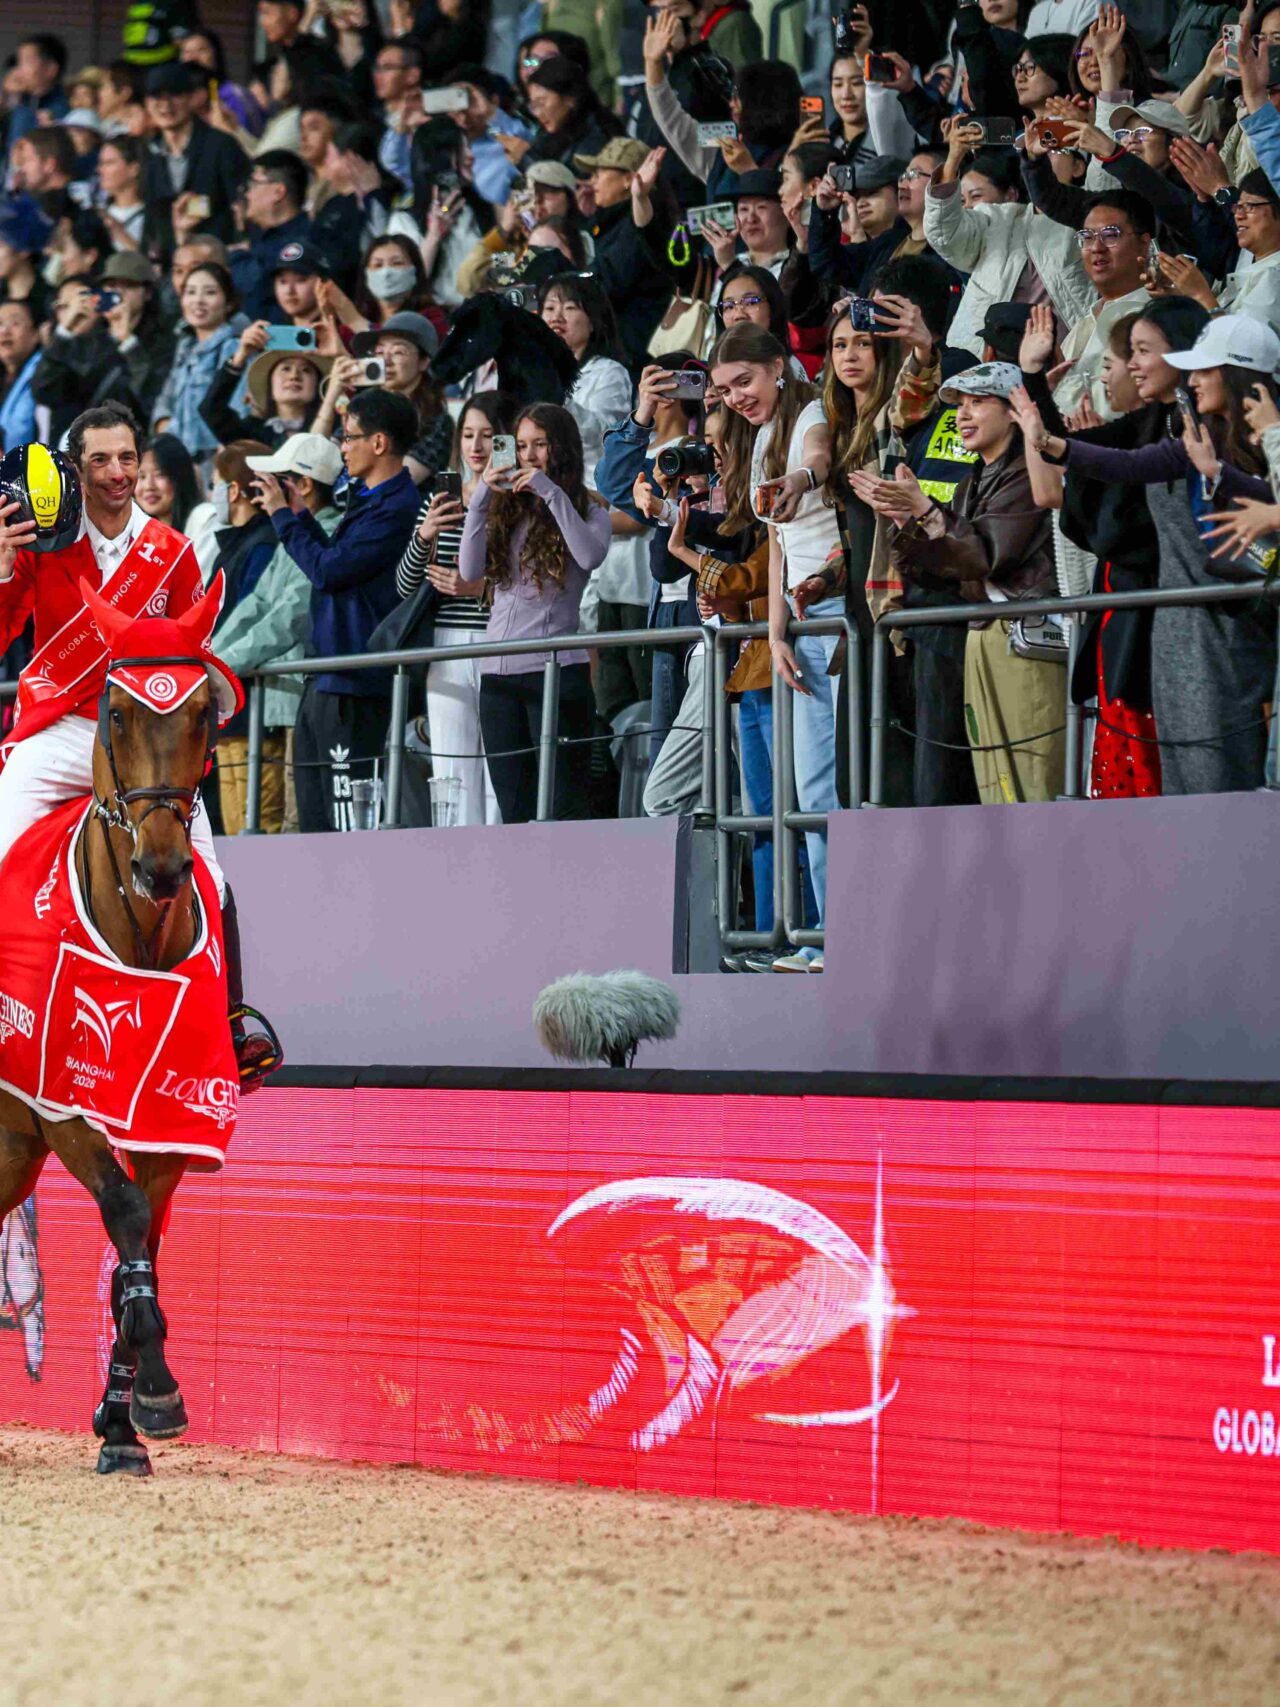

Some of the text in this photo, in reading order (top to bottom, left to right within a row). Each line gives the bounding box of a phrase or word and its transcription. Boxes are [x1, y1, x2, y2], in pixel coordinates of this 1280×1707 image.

[36, 496, 56, 509] QH
[137, 542, 165, 567] 1ST
[58, 630, 90, 660] GLOBAL
[333, 775, 352, 798] 03
[65, 1055, 116, 1082] SHANGHAI
[72, 1073, 96, 1090] 2026
